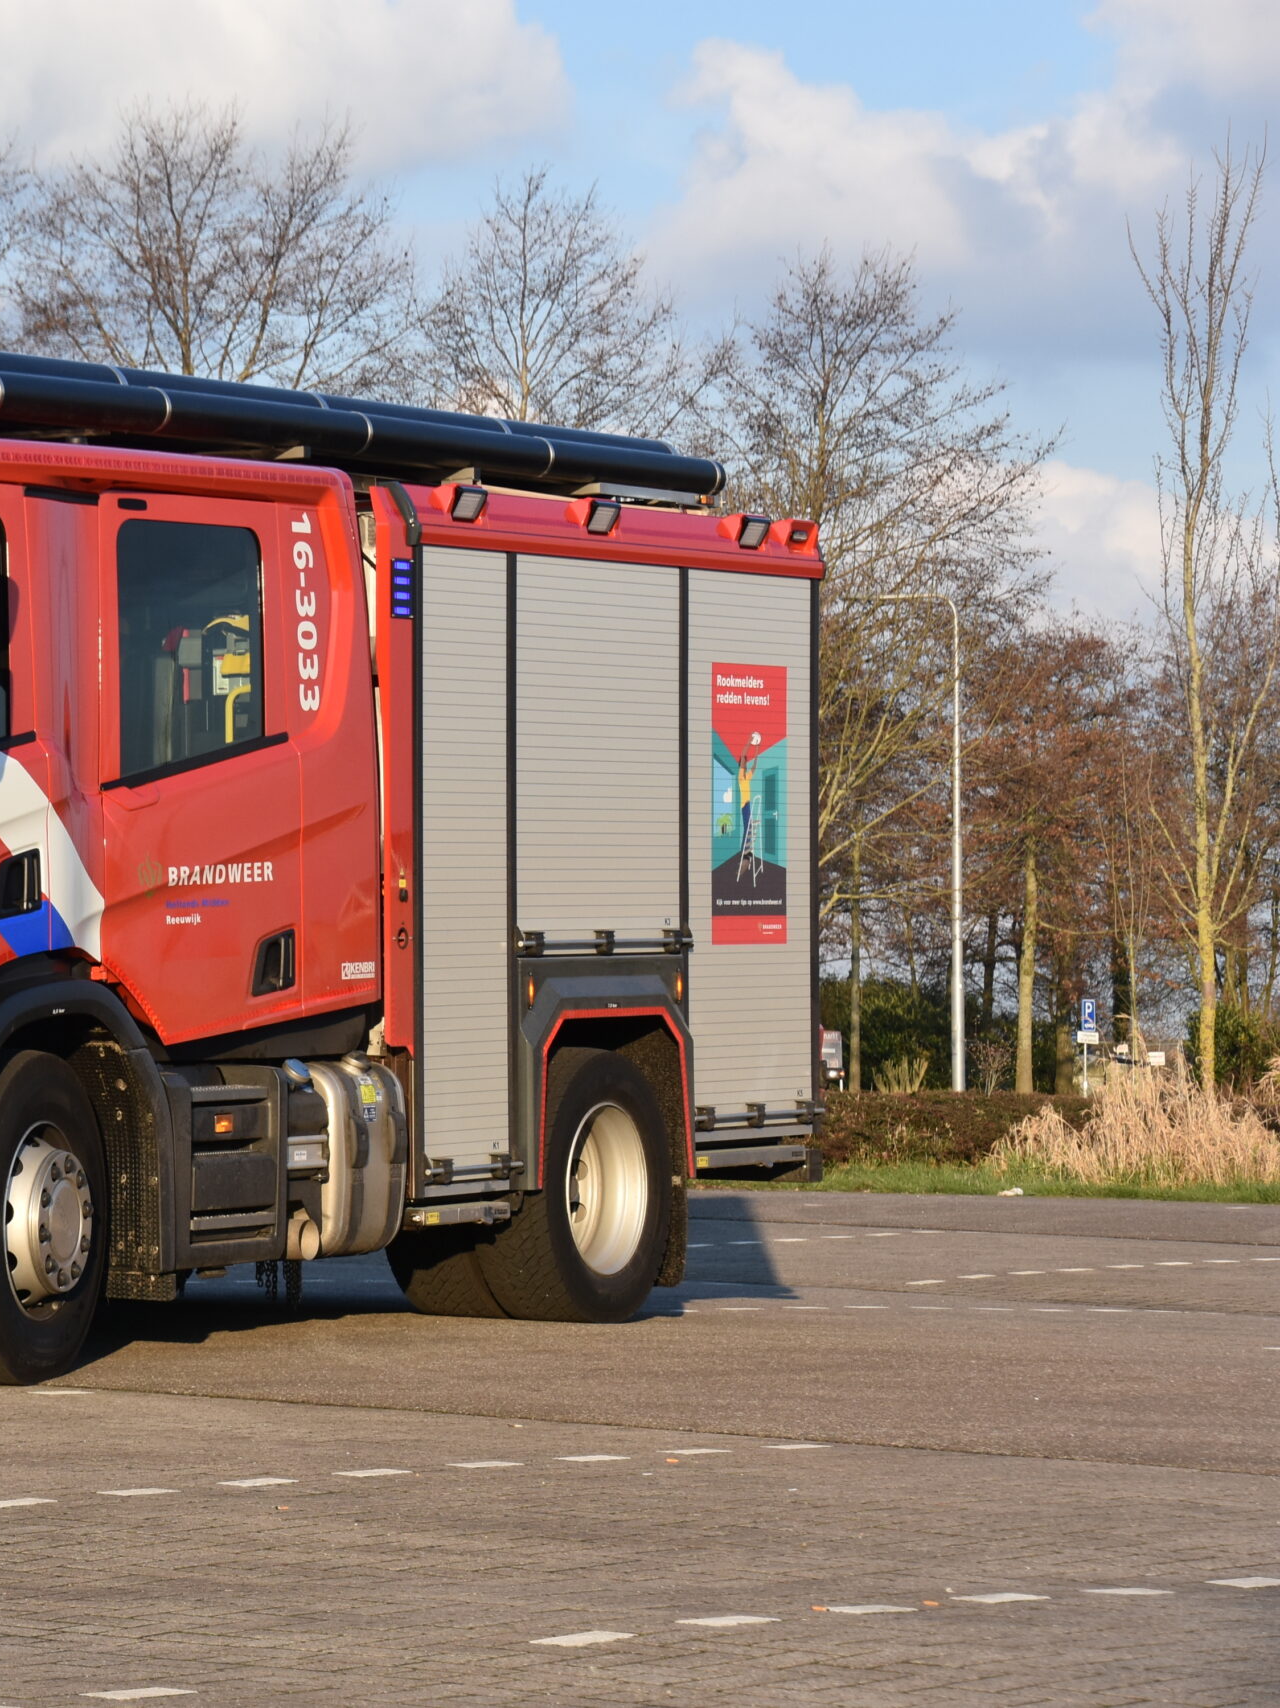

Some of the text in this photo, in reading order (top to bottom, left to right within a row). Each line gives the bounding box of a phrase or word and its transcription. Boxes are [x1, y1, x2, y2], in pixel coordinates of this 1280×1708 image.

[291, 512, 320, 712] 16-3033
[716, 674, 764, 689] Rookmelders
[716, 691, 770, 706] redden levens!
[167, 861, 274, 887] BRANDWEER
[166, 912, 201, 926] Reeuwijk
[350, 961, 376, 974] KENBRI
[1085, 1002, 1093, 1019] P
